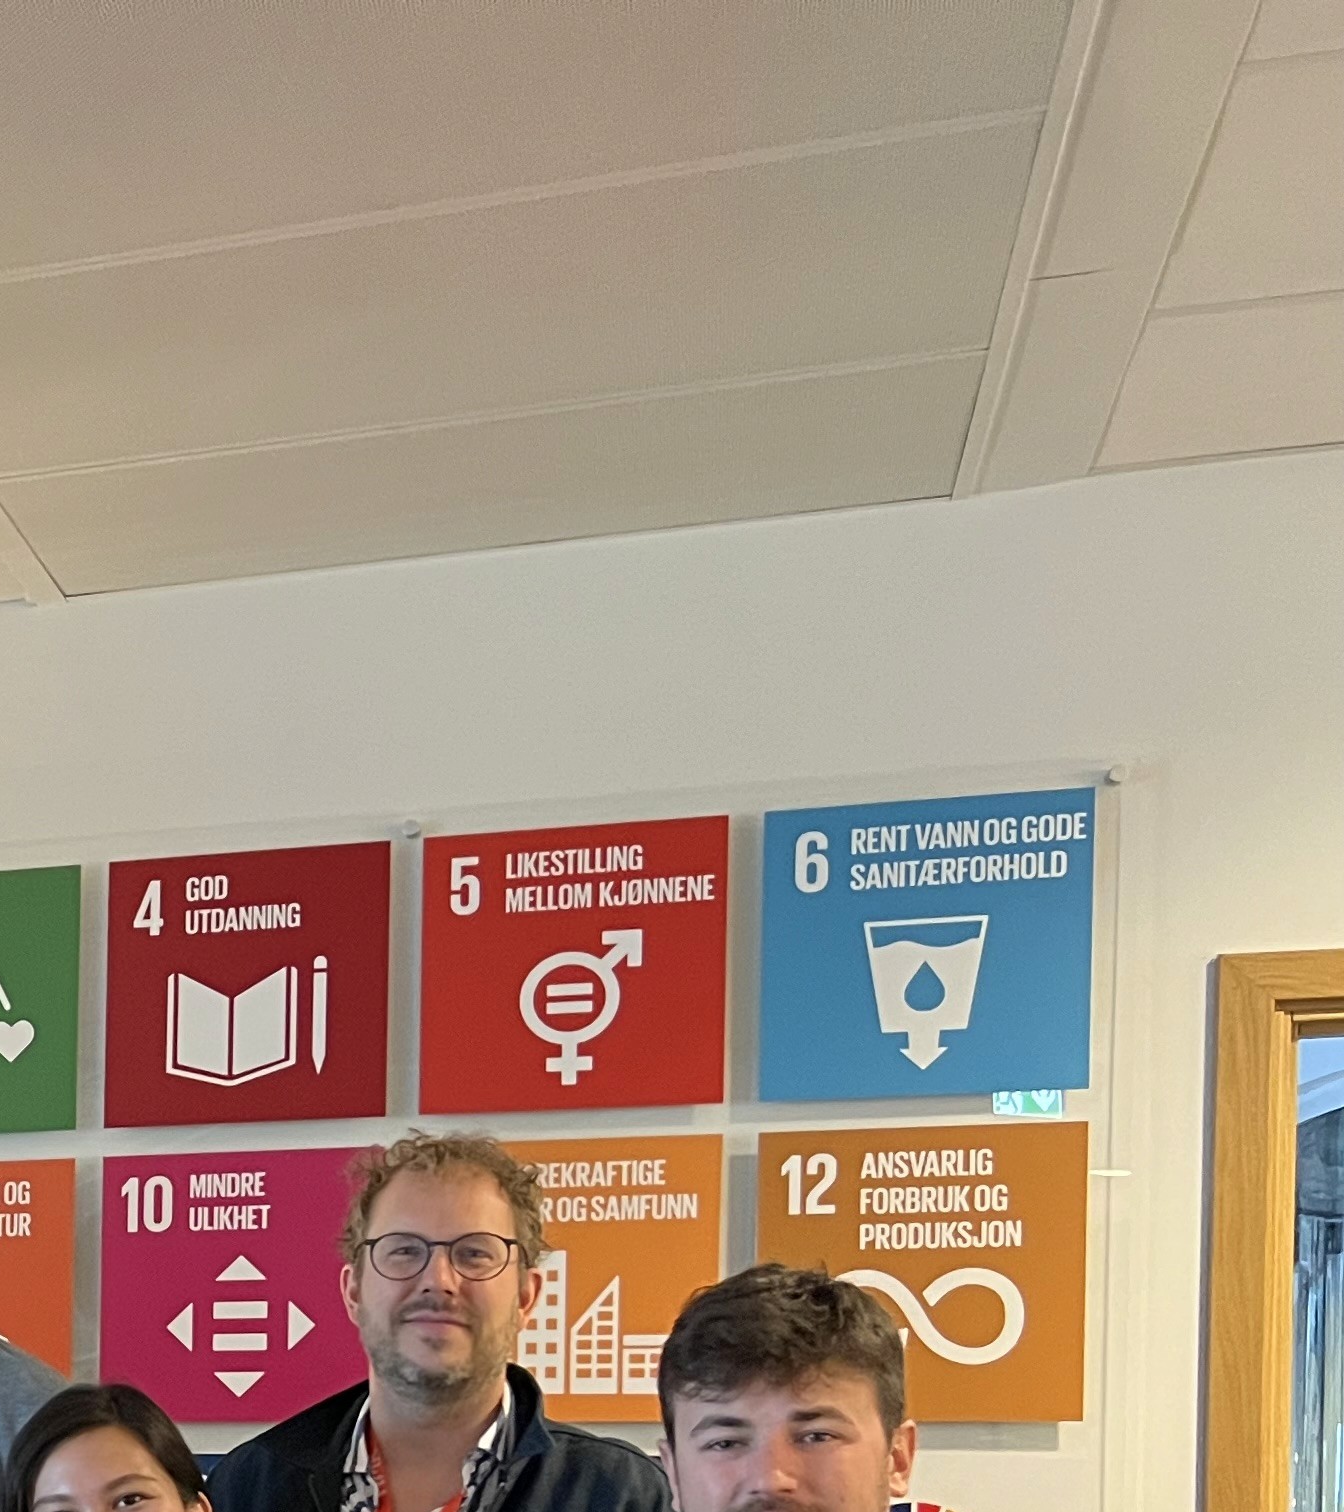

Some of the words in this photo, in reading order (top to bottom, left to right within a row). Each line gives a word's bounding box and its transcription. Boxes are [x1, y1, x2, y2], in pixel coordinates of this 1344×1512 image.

[850, 824, 910, 855] RENT
[910, 820, 977, 852] VANN
[983, 817, 1017, 847] OG
[1020, 811, 1088, 844] GODE
[505, 844, 644, 880] LIKESTILLING
[794, 831, 829, 893] 6
[849, 849, 1069, 891] SANITÆRFORHOLD
[185, 875, 228, 901] GOD
[450, 856, 480, 916] 5
[505, 882, 593, 914] MELLOM
[598, 874, 715, 909] KJØNNENE
[133, 879, 163, 936] 4
[185, 902, 302, 934] UTDANNING
[536, 1159, 666, 1188] REKRAFTIGE
[860, 1148, 992, 1179] ANSVARLIG
[3, 1181, 31, 1205] OG
[189, 1172, 265, 1199] MINDRE
[780, 1153, 838, 1216] 12
[859, 1186, 969, 1215] FORBRUK
[973, 1184, 1008, 1212] OG
[121, 1175, 173, 1233] 10
[189, 1204, 271, 1232] ULIKHET
[557, 1196, 587, 1222] OG
[591, 1193, 698, 1221] SAMFUNN
[858, 1219, 1022, 1251] PRODUKSJON
